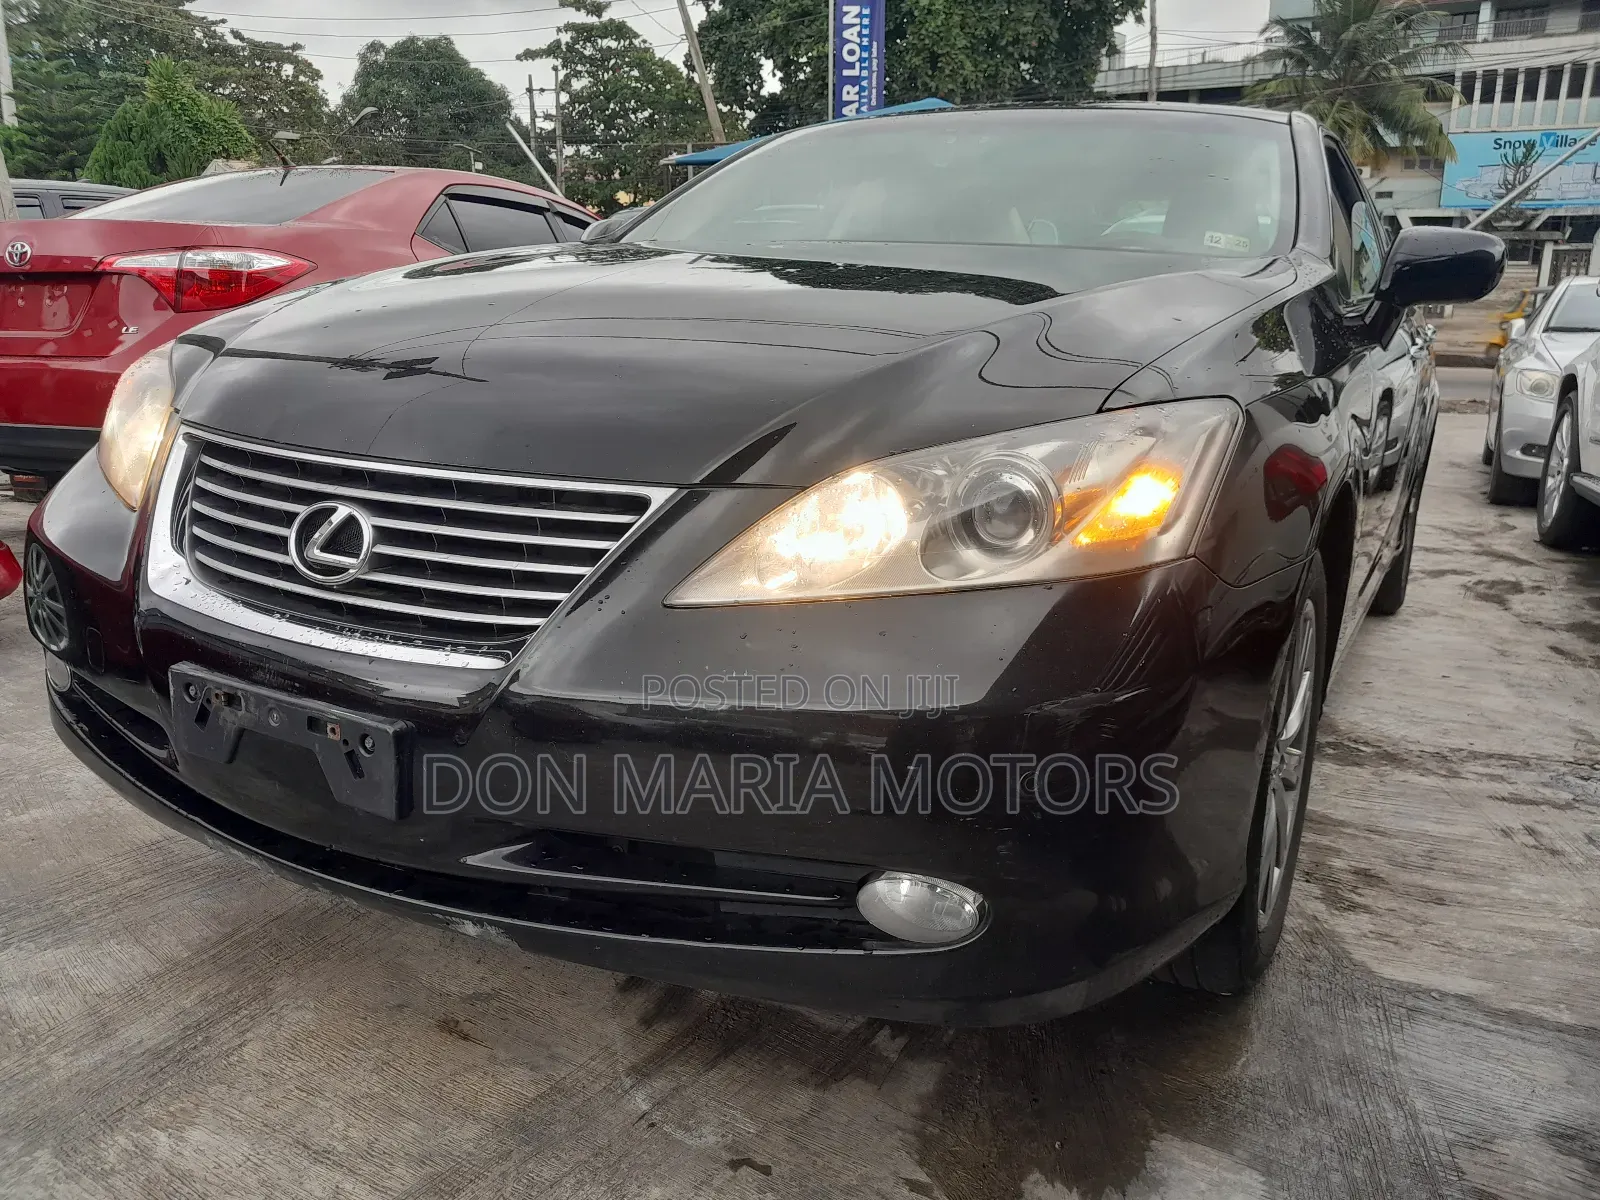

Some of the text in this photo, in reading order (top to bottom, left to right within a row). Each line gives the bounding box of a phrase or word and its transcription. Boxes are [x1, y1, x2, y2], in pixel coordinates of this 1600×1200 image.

[861, 6, 871, 46] HERE
[842, 5, 861, 77] LOAN
[1540, 134, 1598, 150] Villae
[1206, 234, 1222, 245] 12
[121, 326, 139, 334] LE
